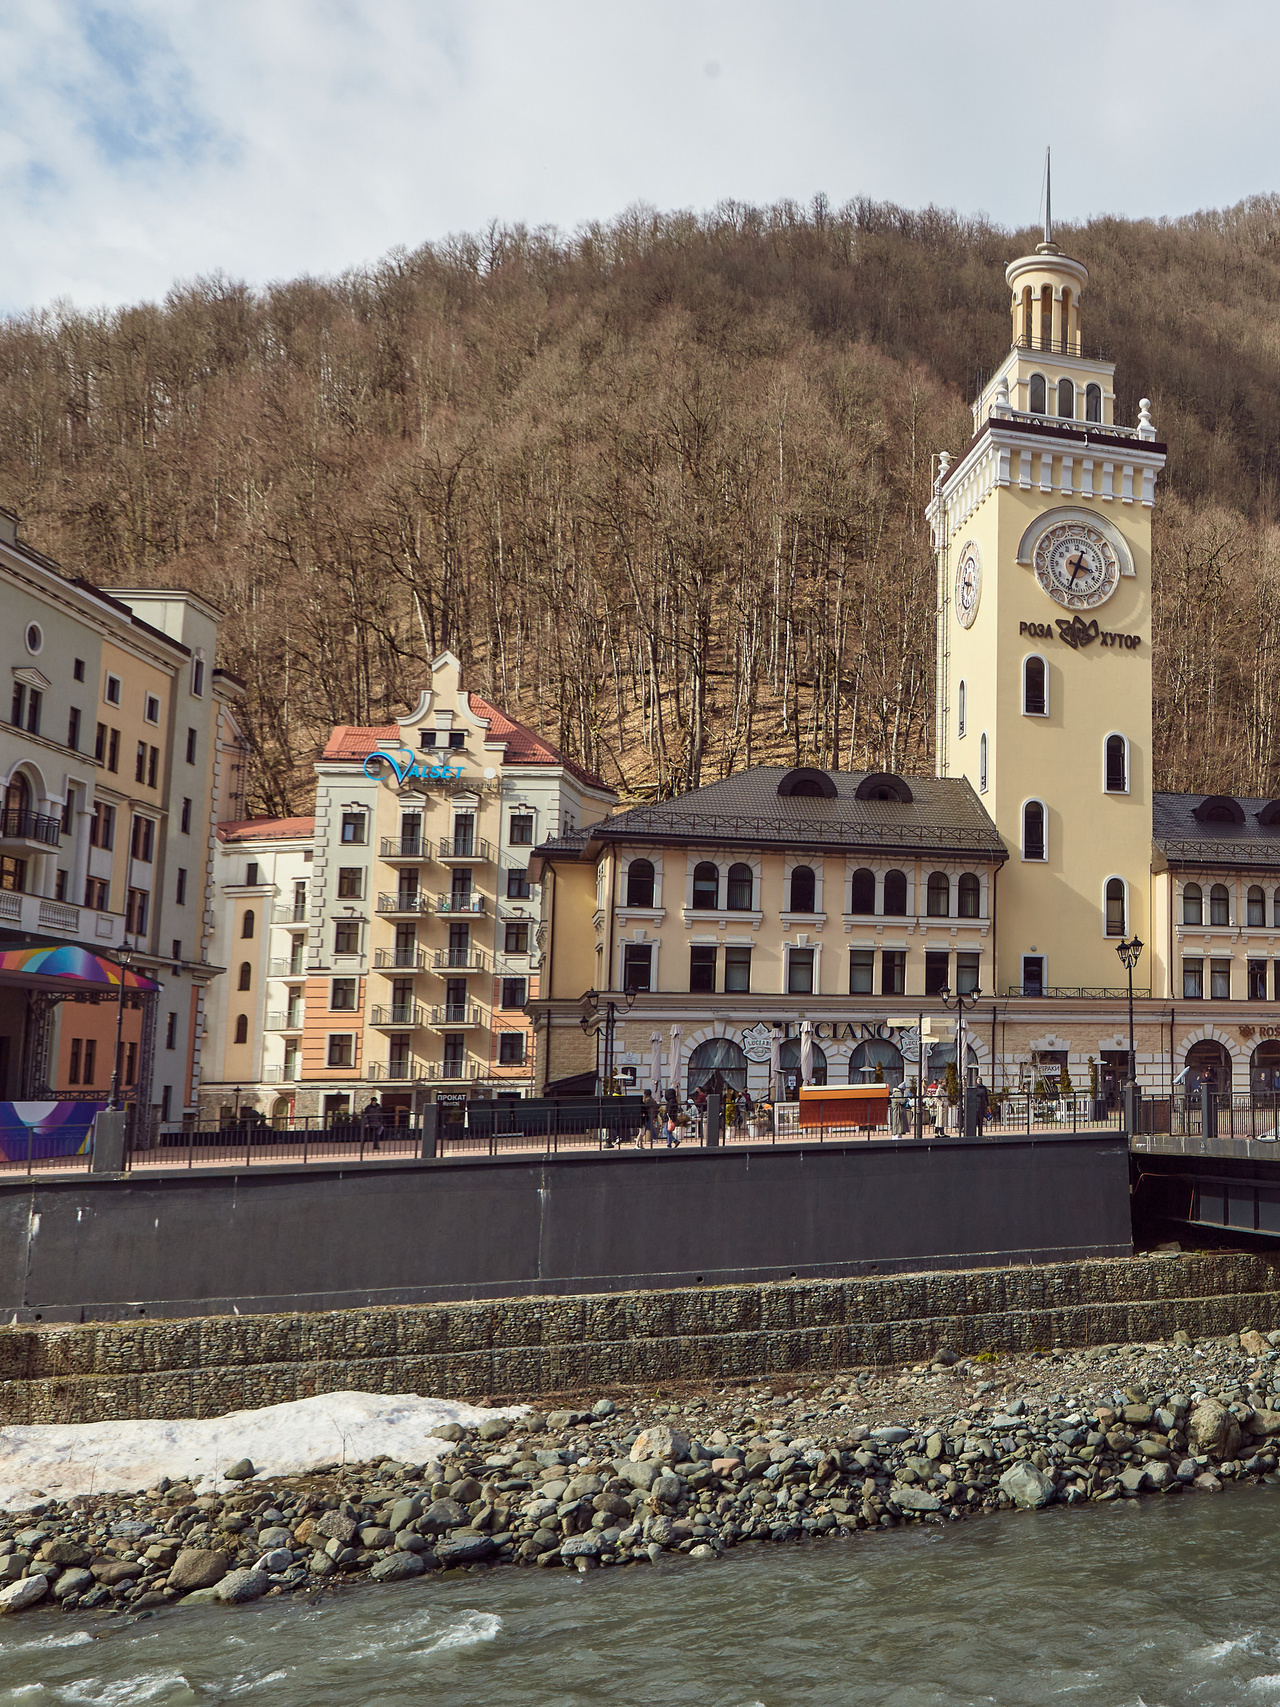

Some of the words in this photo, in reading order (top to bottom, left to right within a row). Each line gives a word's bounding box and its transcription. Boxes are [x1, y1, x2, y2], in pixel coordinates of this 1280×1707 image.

[1019, 621, 1054, 639] РОЗА
[1100, 631, 1141, 649] ХУТОР
[363, 749, 466, 786] VALSET
